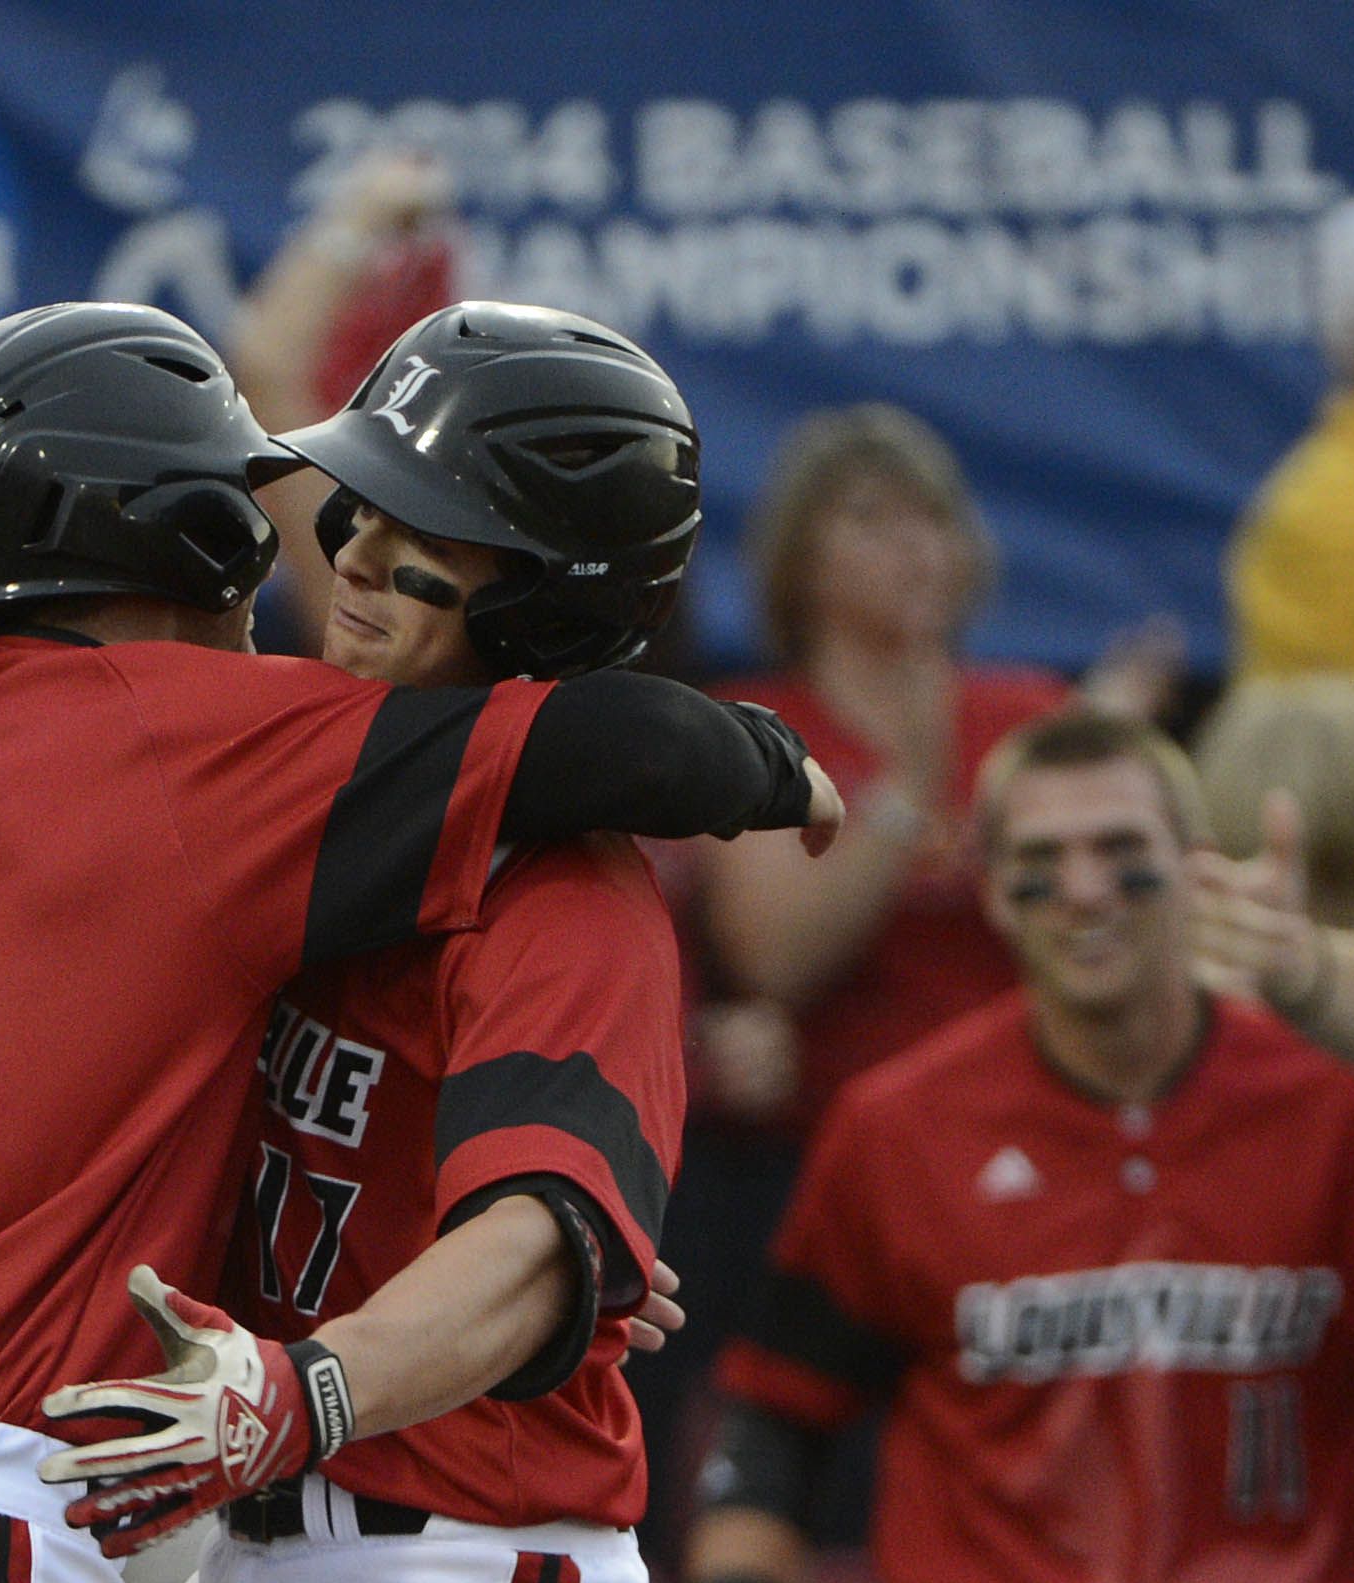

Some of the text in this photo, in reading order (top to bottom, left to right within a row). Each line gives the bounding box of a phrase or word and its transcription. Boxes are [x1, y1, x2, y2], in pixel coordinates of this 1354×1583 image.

[640, 98, 1345, 212] BASEBALL
[455, 212, 1325, 345] AMPIONSHI
[372, 355, 442, 436] L
[256, 1140, 362, 1317] 17
[953, 1262, 1342, 1386] LOUISVILLE
